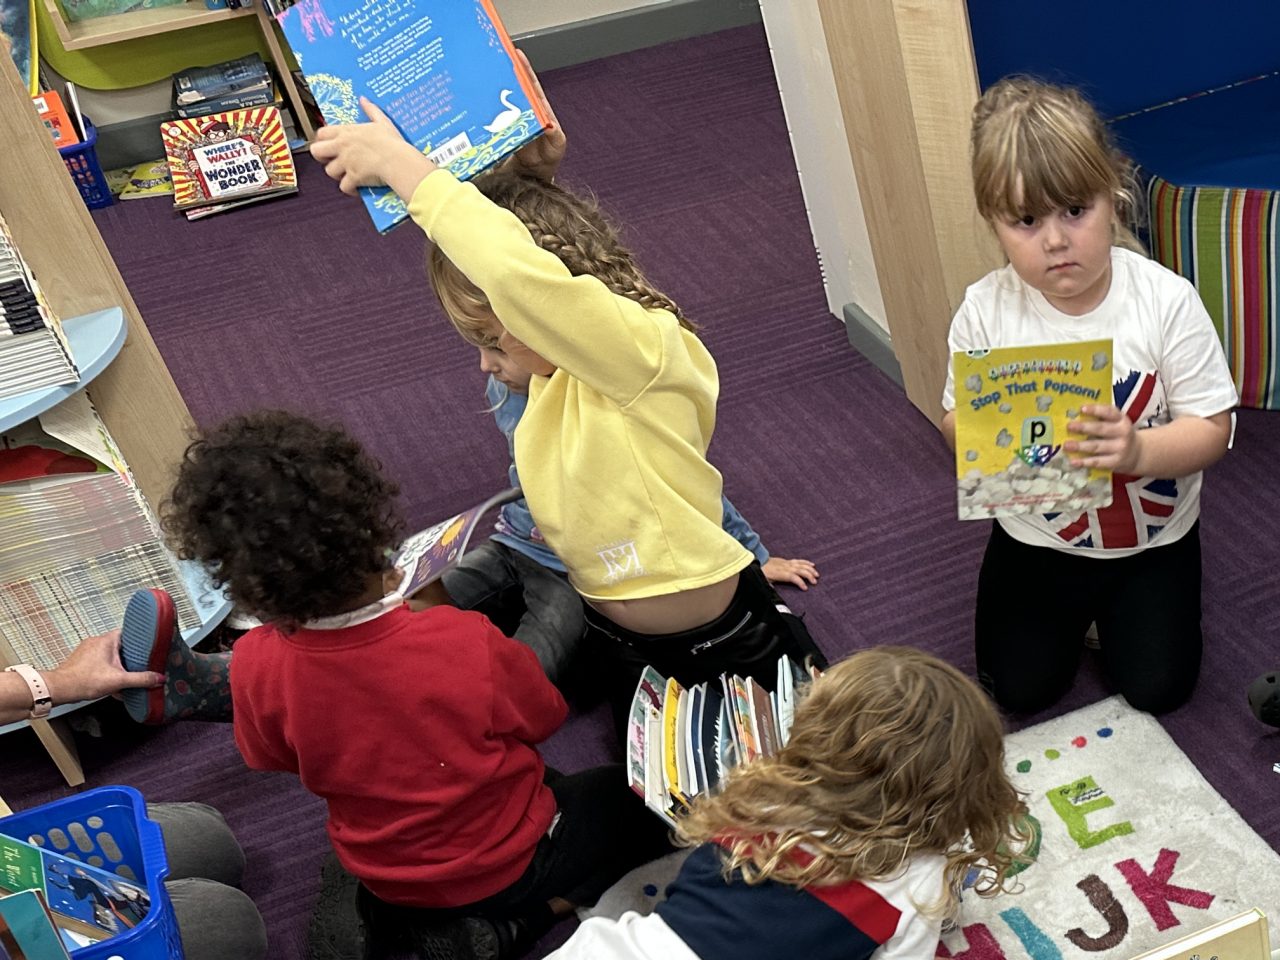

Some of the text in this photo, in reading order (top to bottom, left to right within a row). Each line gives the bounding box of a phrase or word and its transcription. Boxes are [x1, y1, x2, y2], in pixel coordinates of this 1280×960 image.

[204, 141, 245, 156] WHERE'S
[205, 160, 261, 181] WONDER
[219, 173, 258, 190] BOOK
[970, 379, 1101, 411] Stop That Popcorn!
[1031, 421, 1046, 443] p
[4, 846, 21, 862] The
